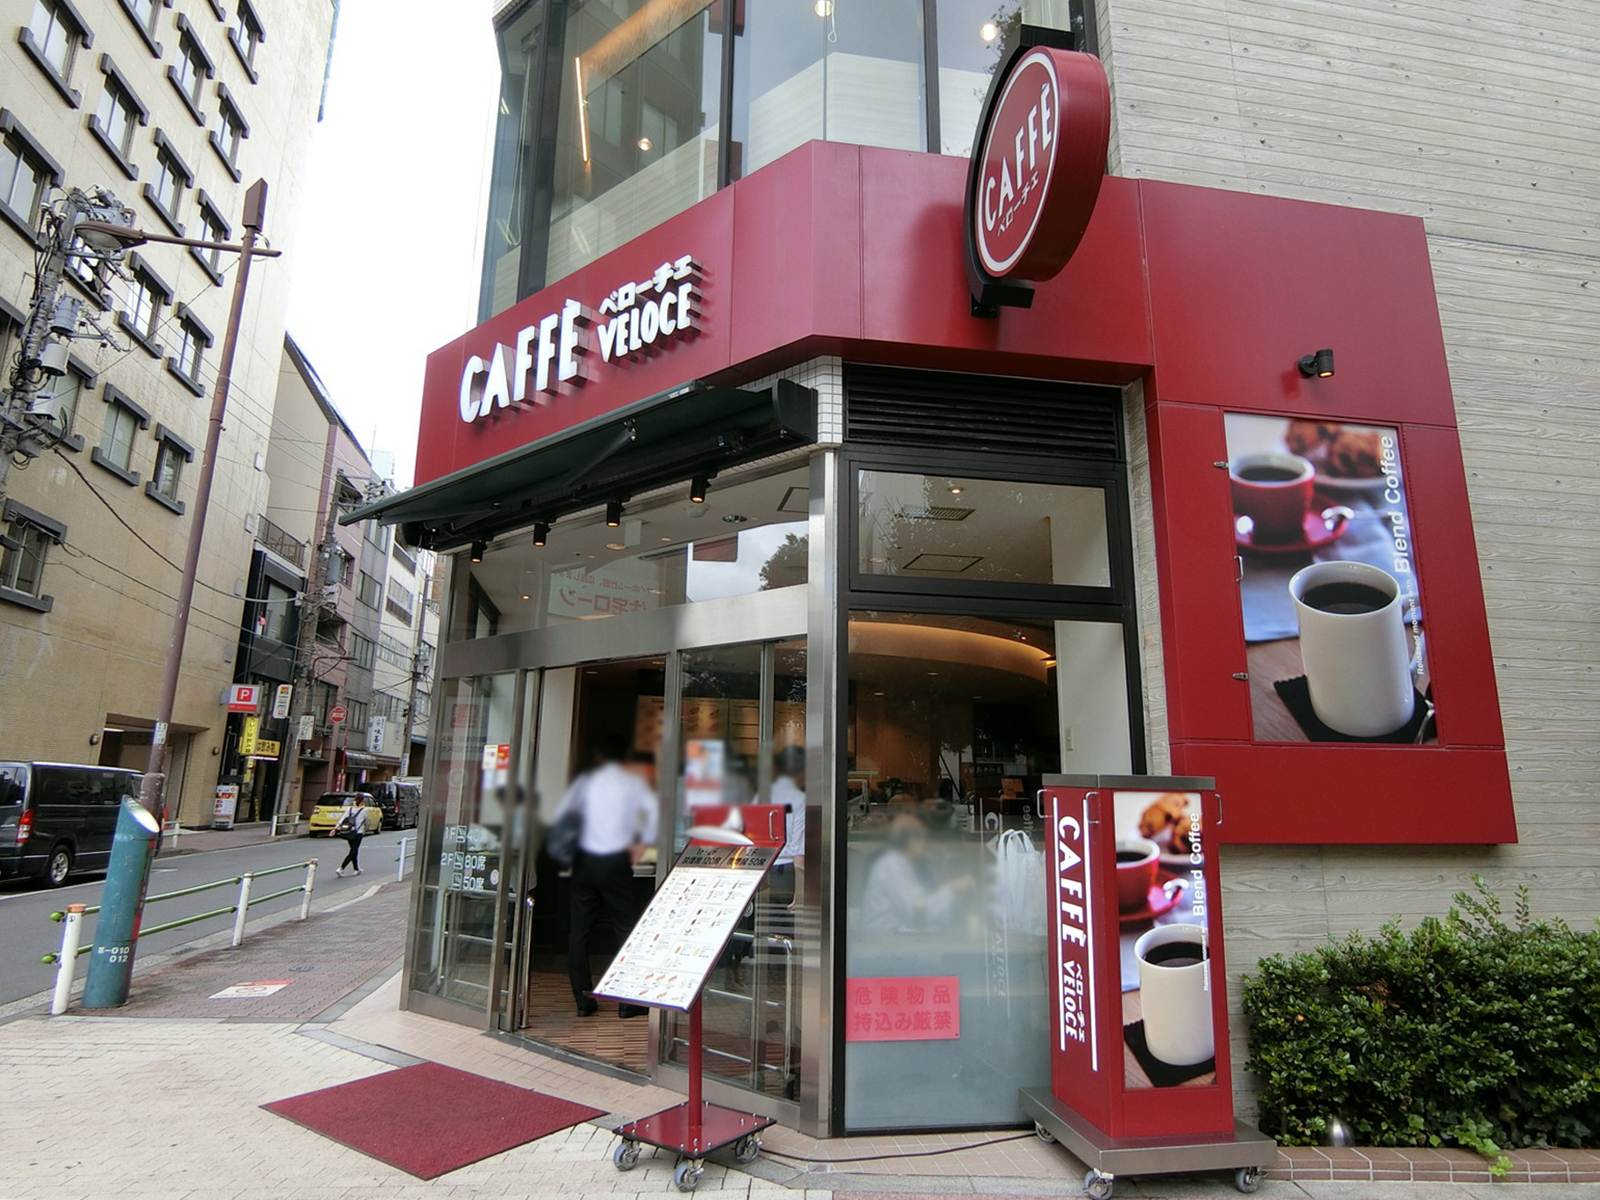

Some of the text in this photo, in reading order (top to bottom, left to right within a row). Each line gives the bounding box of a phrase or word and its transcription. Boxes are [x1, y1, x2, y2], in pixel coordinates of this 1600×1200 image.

[997, 171, 1039, 237] ベローチェ
[599, 254, 693, 316] ベローチェ
[597, 282, 693, 363] VELOCE
[1380, 436, 1411, 573] Blend Coffee
[1405, 579, 1424, 675] Released moment with
[241, 689, 250, 700] P
[445, 826, 456, 839] 1F
[440, 852, 454, 866] 2F
[464, 855, 487, 871] 80席
[1188, 812, 1205, 917] Blend Coffee
[463, 876, 485, 891] 50席
[109, 955, 128, 963] 012
[854, 984, 951, 1006] 危険物品
[1063, 960, 1078, 1041] VELOCE
[1073, 963, 1085, 1043] ベローチェ
[854, 1010, 952, 1032] 持込み厳禁
